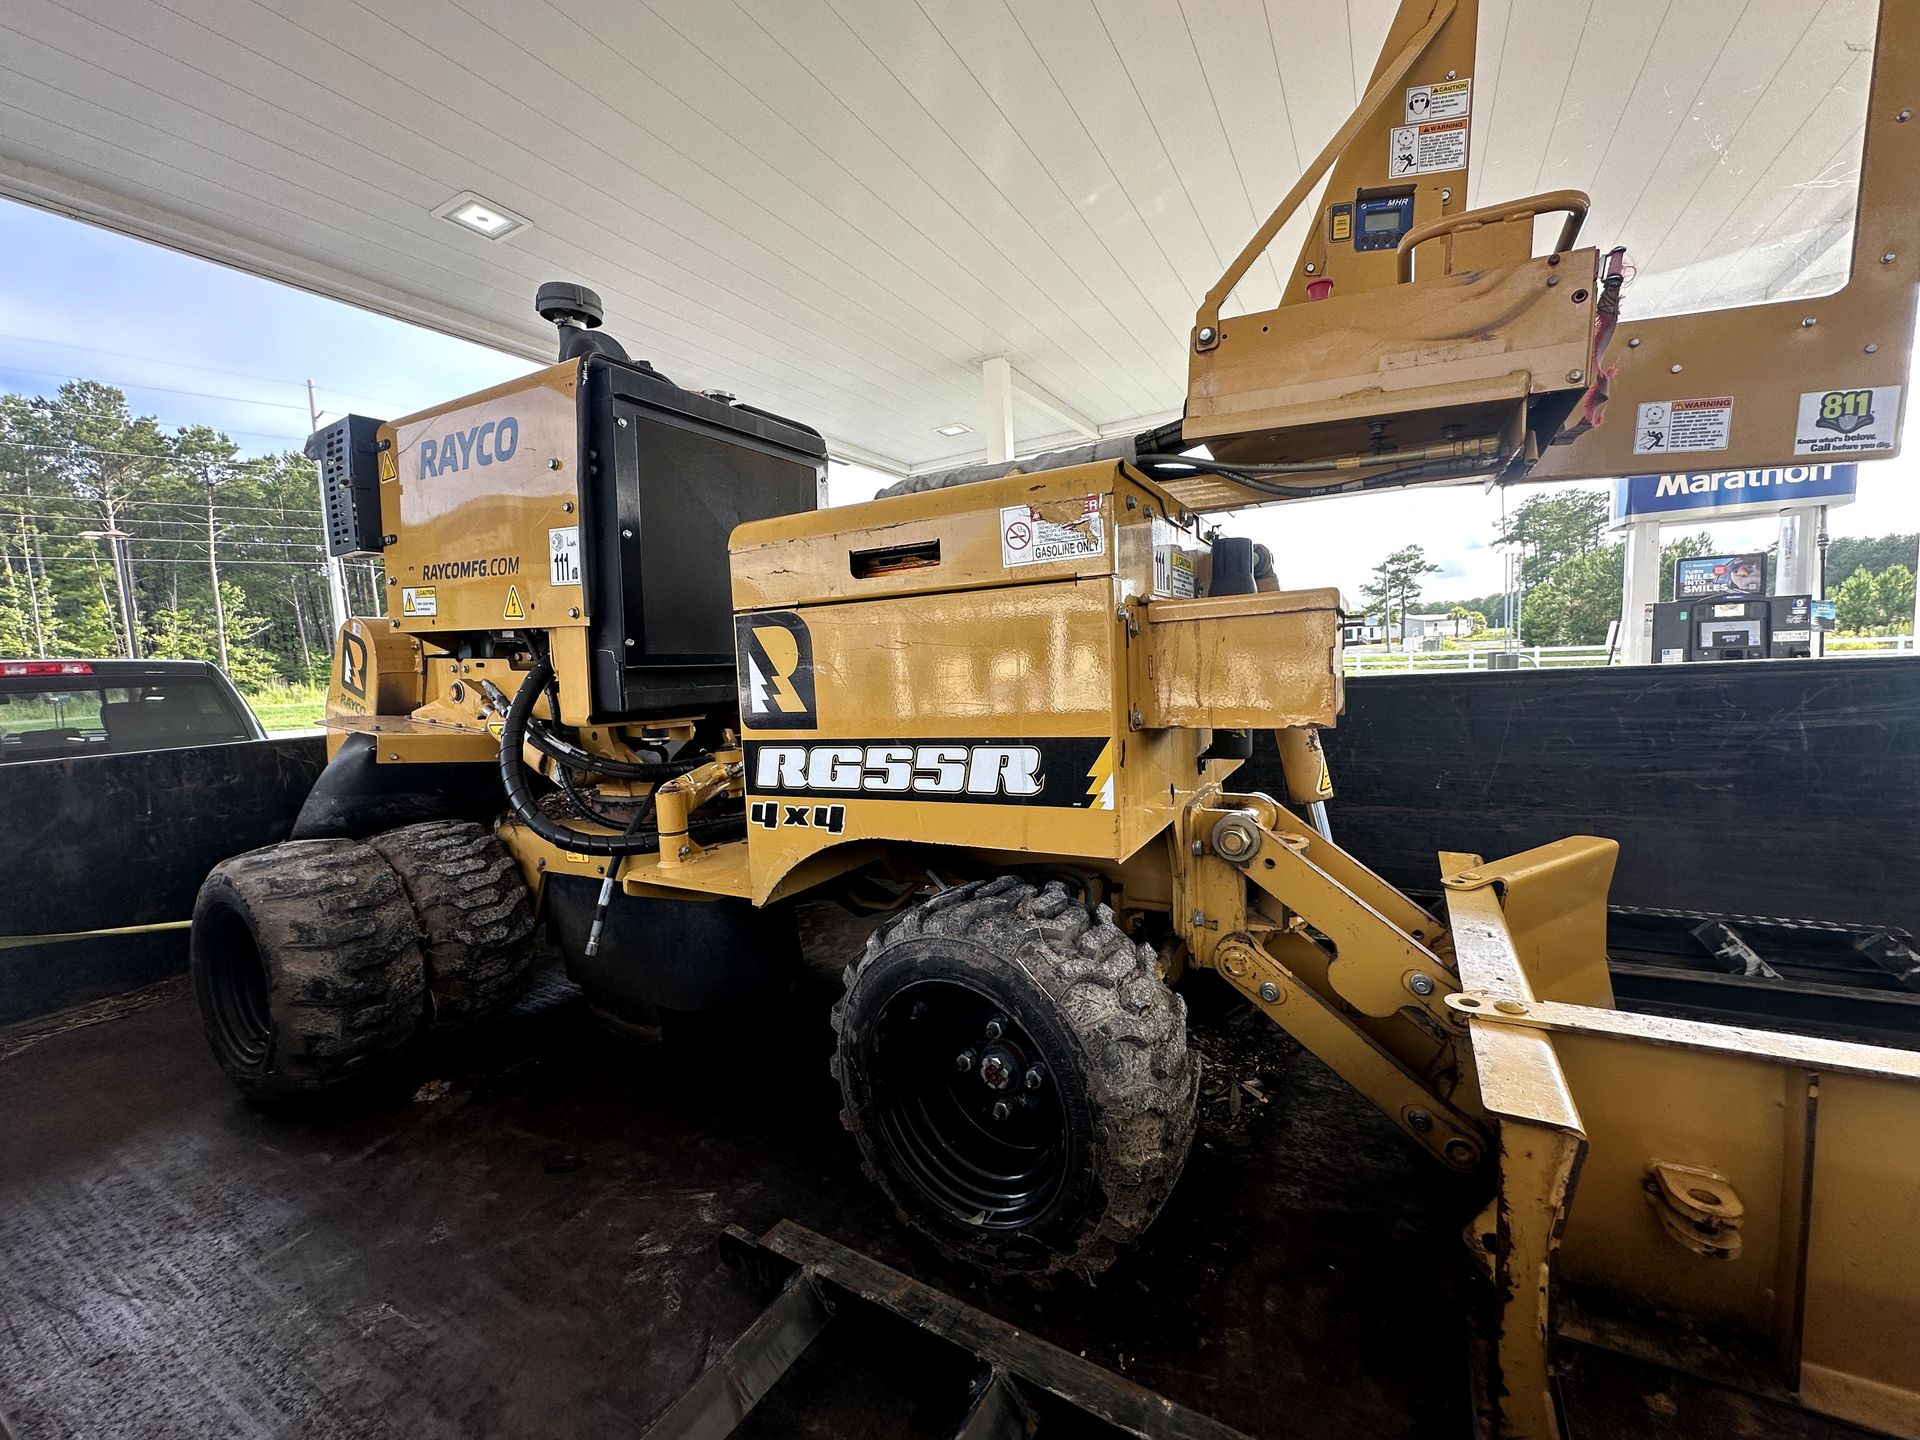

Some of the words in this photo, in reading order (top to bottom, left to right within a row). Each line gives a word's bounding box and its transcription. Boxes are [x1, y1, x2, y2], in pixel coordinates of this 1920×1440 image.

[1439, 84, 1467, 92] CAUTION
[1431, 122, 1463, 131] WARNING
[1387, 198, 1408, 206] MHR
[1685, 400, 1730, 409] WARNING
[1823, 392, 1869, 419] 811
[420, 416, 519, 480] RAYCO
[1810, 443, 1831, 452] Call
[1035, 542, 1075, 558] GASOLINE
[1077, 539, 1099, 553] ONLY
[422, 557, 520, 581] RAYCOMFG.COM
[554, 553, 569, 581] 111
[1684, 584, 1728, 593] SMILES
[340, 693, 367, 716] RAYCO
[749, 800, 846, 835] 4x4
